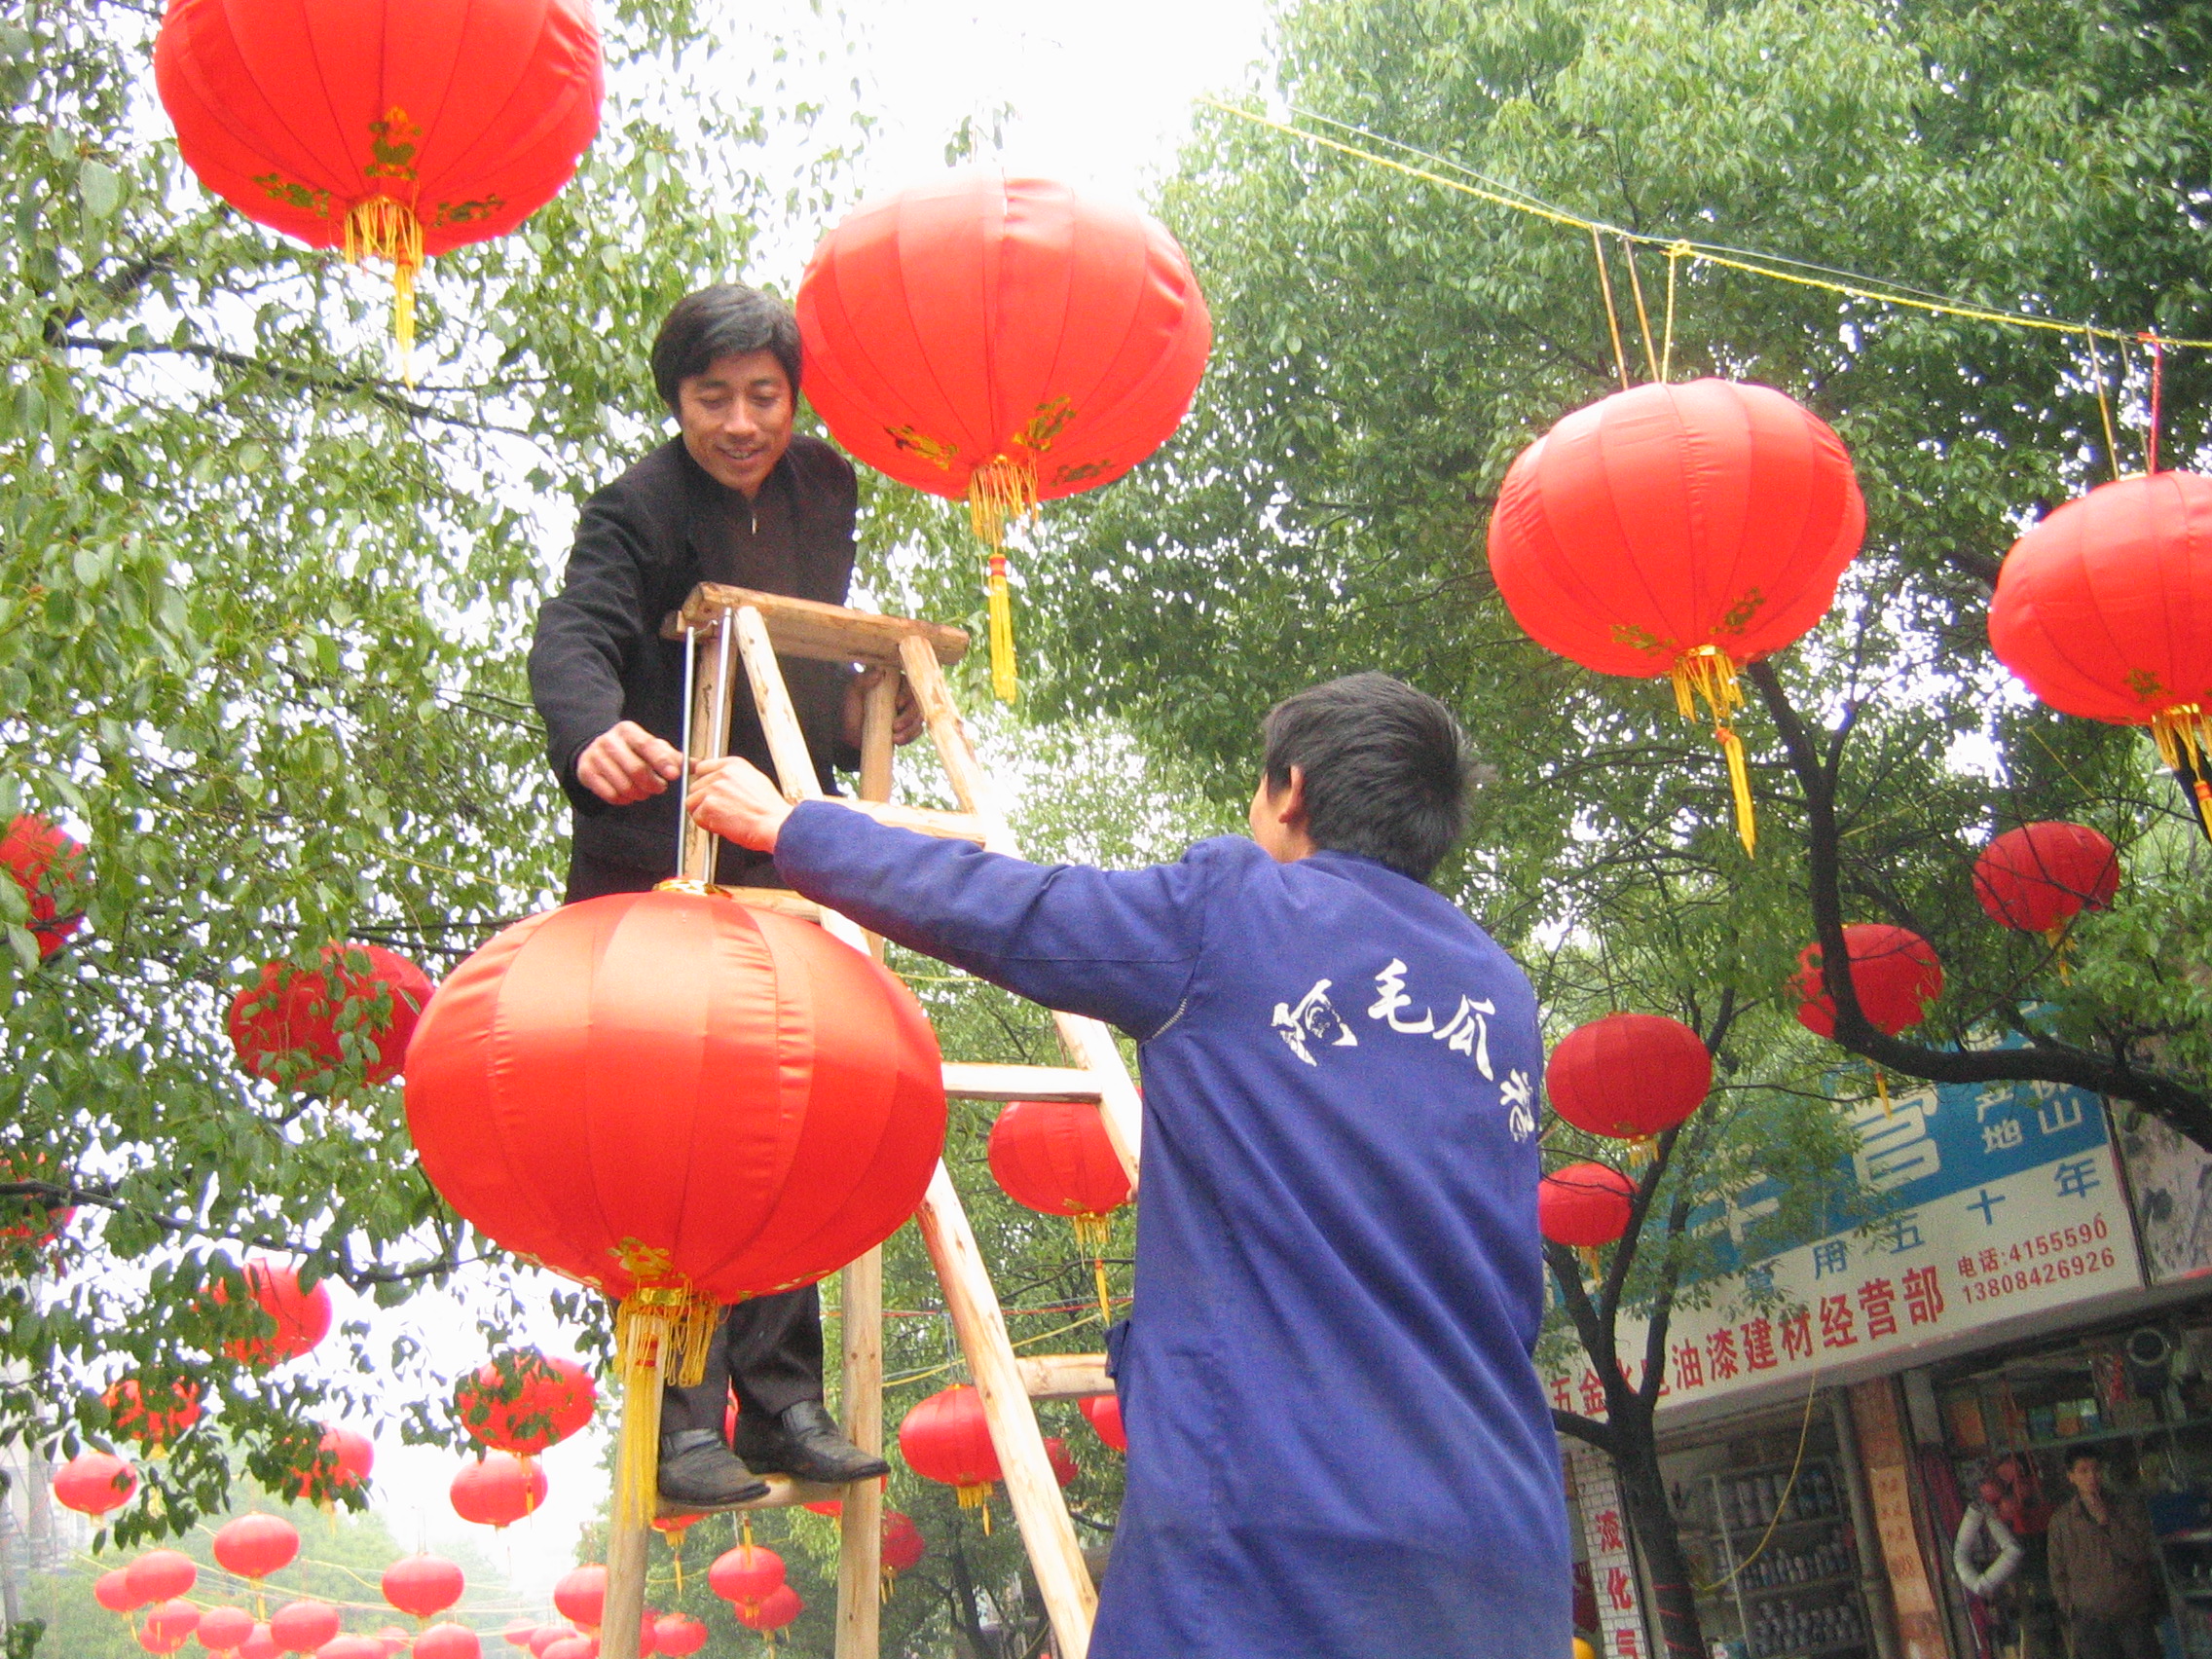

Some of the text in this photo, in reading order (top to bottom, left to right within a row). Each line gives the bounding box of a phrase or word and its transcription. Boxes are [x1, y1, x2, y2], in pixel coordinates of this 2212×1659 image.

[1962, 1246, 2116, 1305] 13808426926
[1550, 1265, 1945, 1417] 五金油漆建材经营部
